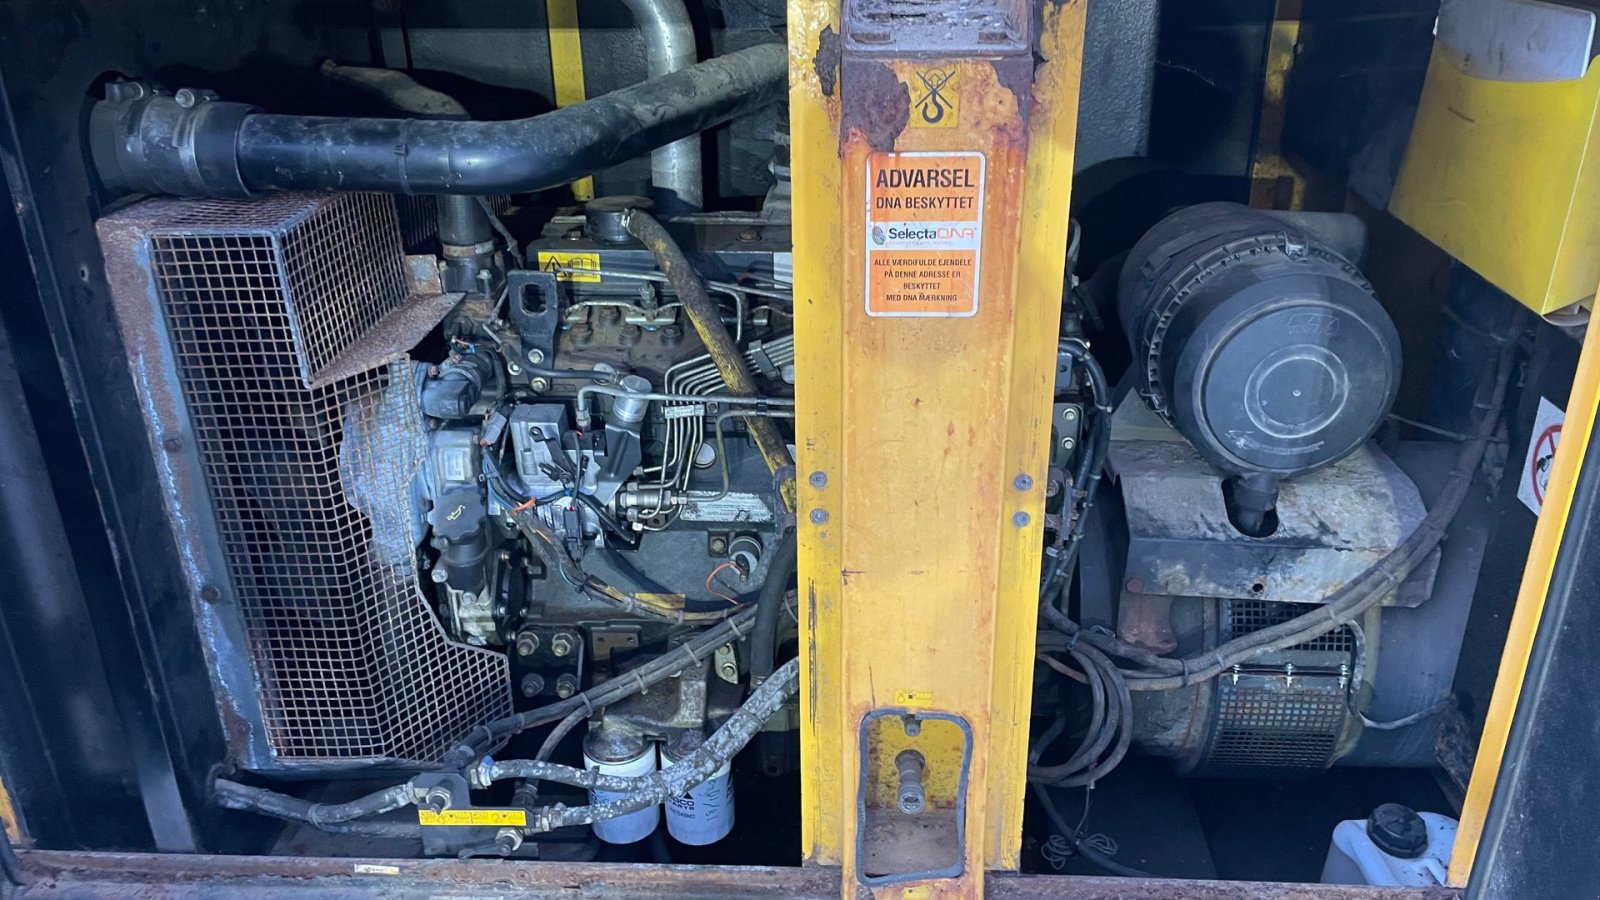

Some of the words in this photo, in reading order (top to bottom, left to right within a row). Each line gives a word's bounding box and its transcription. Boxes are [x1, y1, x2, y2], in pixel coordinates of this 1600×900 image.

[876, 169, 974, 188] ADVARSEL
[876, 197, 901, 209] DNA
[905, 197, 974, 209] BESKYTTET
[884, 269, 893, 278] PÅ
